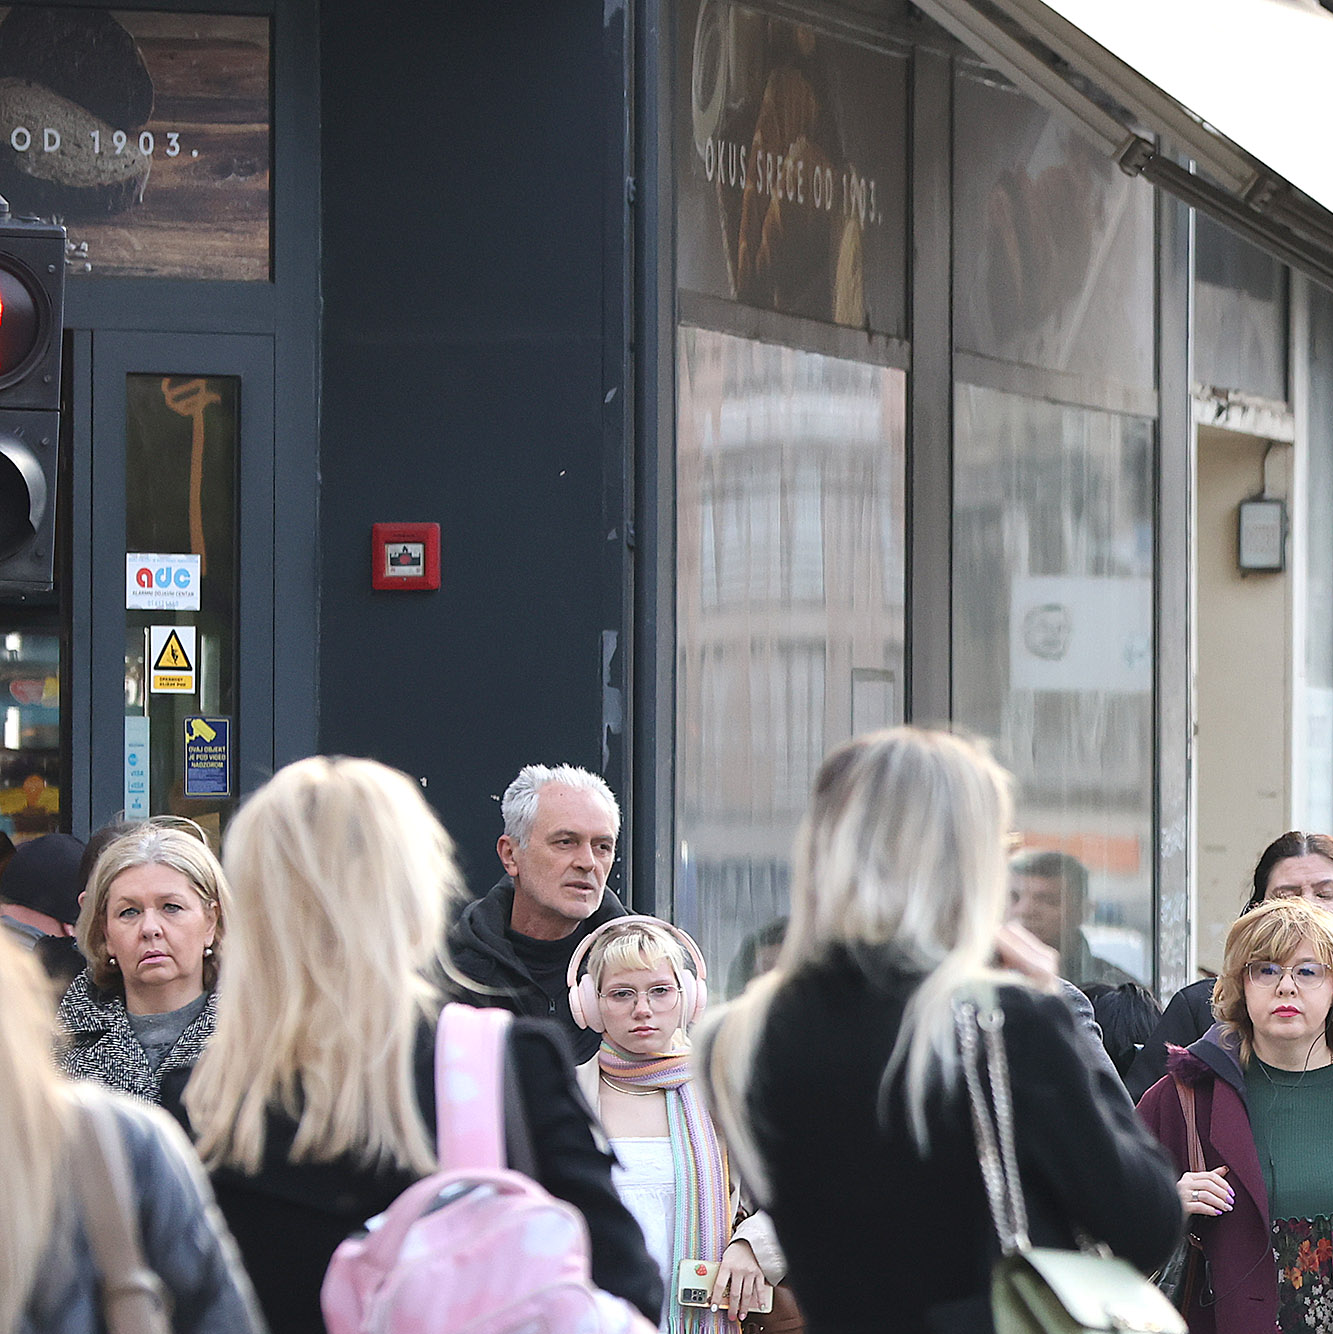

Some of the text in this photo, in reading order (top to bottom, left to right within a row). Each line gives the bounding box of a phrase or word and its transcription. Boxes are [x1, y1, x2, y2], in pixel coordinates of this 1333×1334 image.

[11, 126, 199, 158] OD 1903.
[705, 136, 747, 190] OKUS
[813, 165, 833, 211] OD
[136, 567, 191, 588] adc
